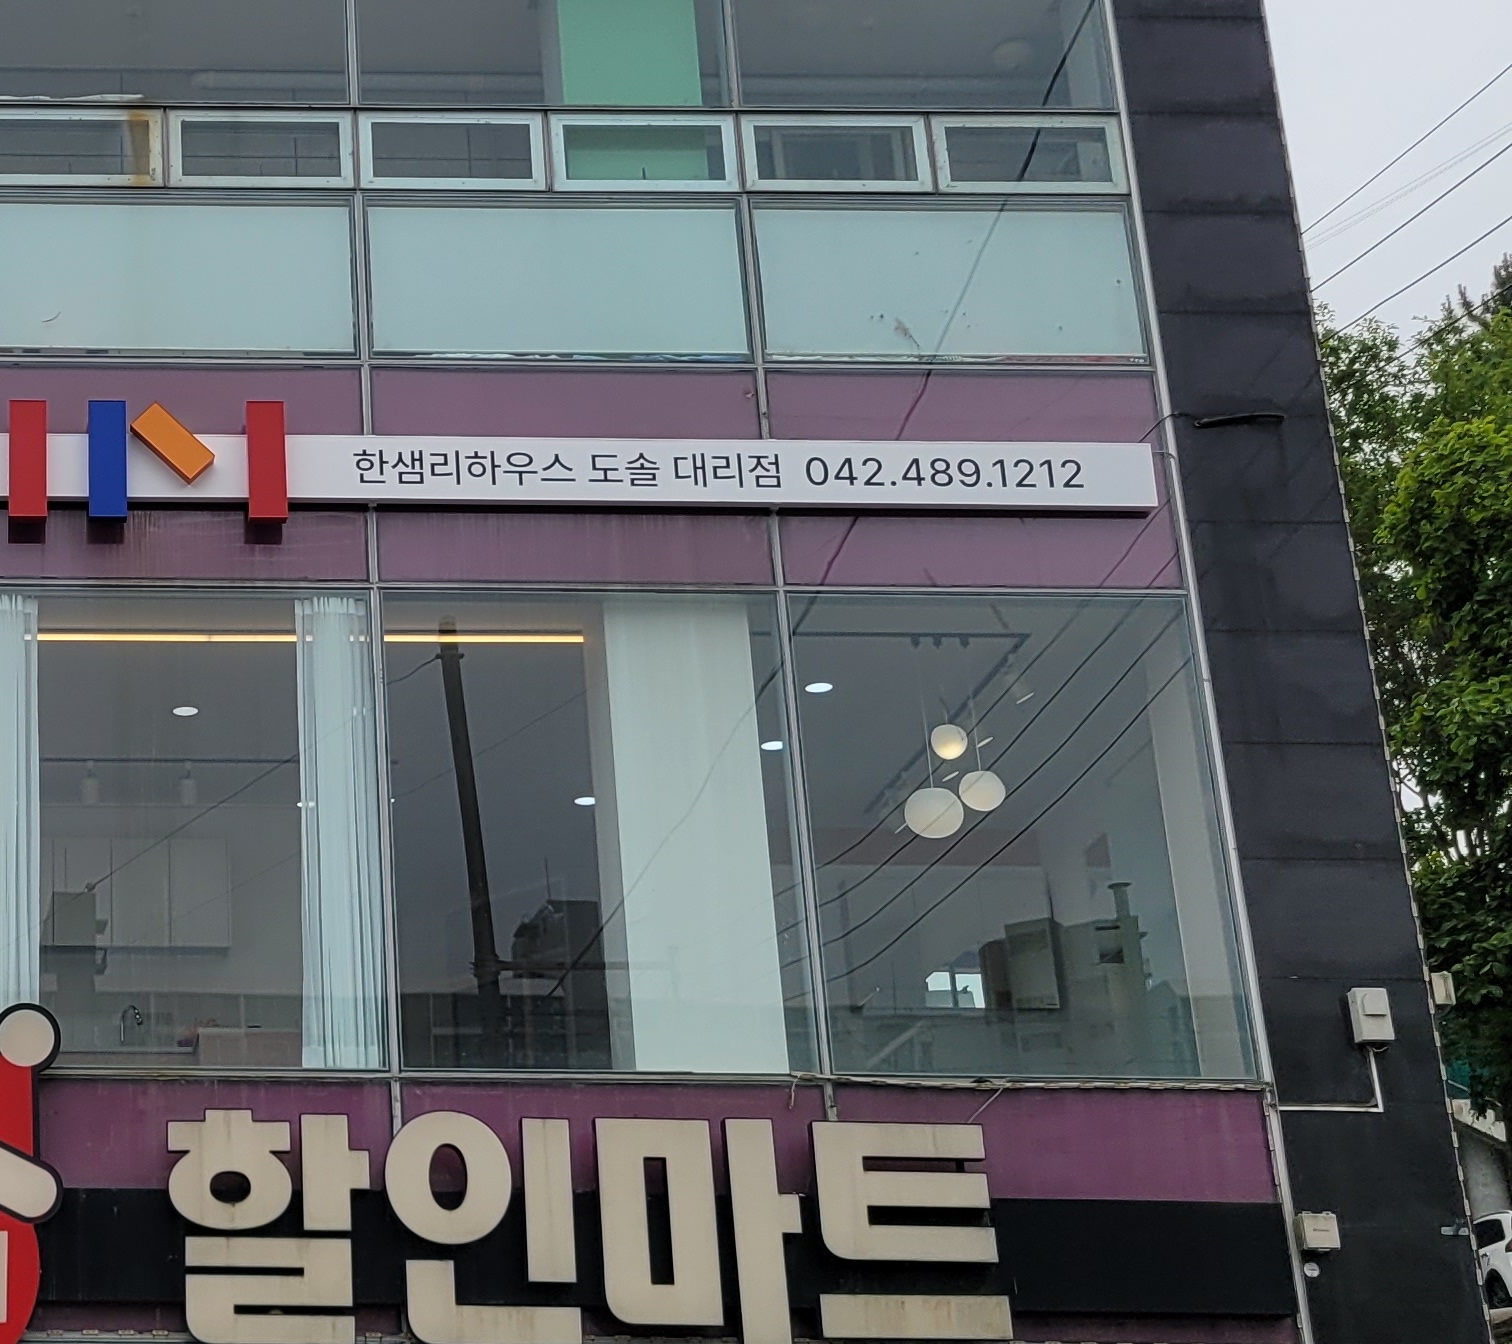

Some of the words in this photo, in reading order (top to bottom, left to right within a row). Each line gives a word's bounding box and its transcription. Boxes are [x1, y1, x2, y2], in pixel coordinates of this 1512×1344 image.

[352, 449, 577, 488] 한샘리하우스
[588, 452, 661, 489] 도솔
[673, 452, 783, 490] 대리점
[804, 456, 1086, 491] 042.489.1212
